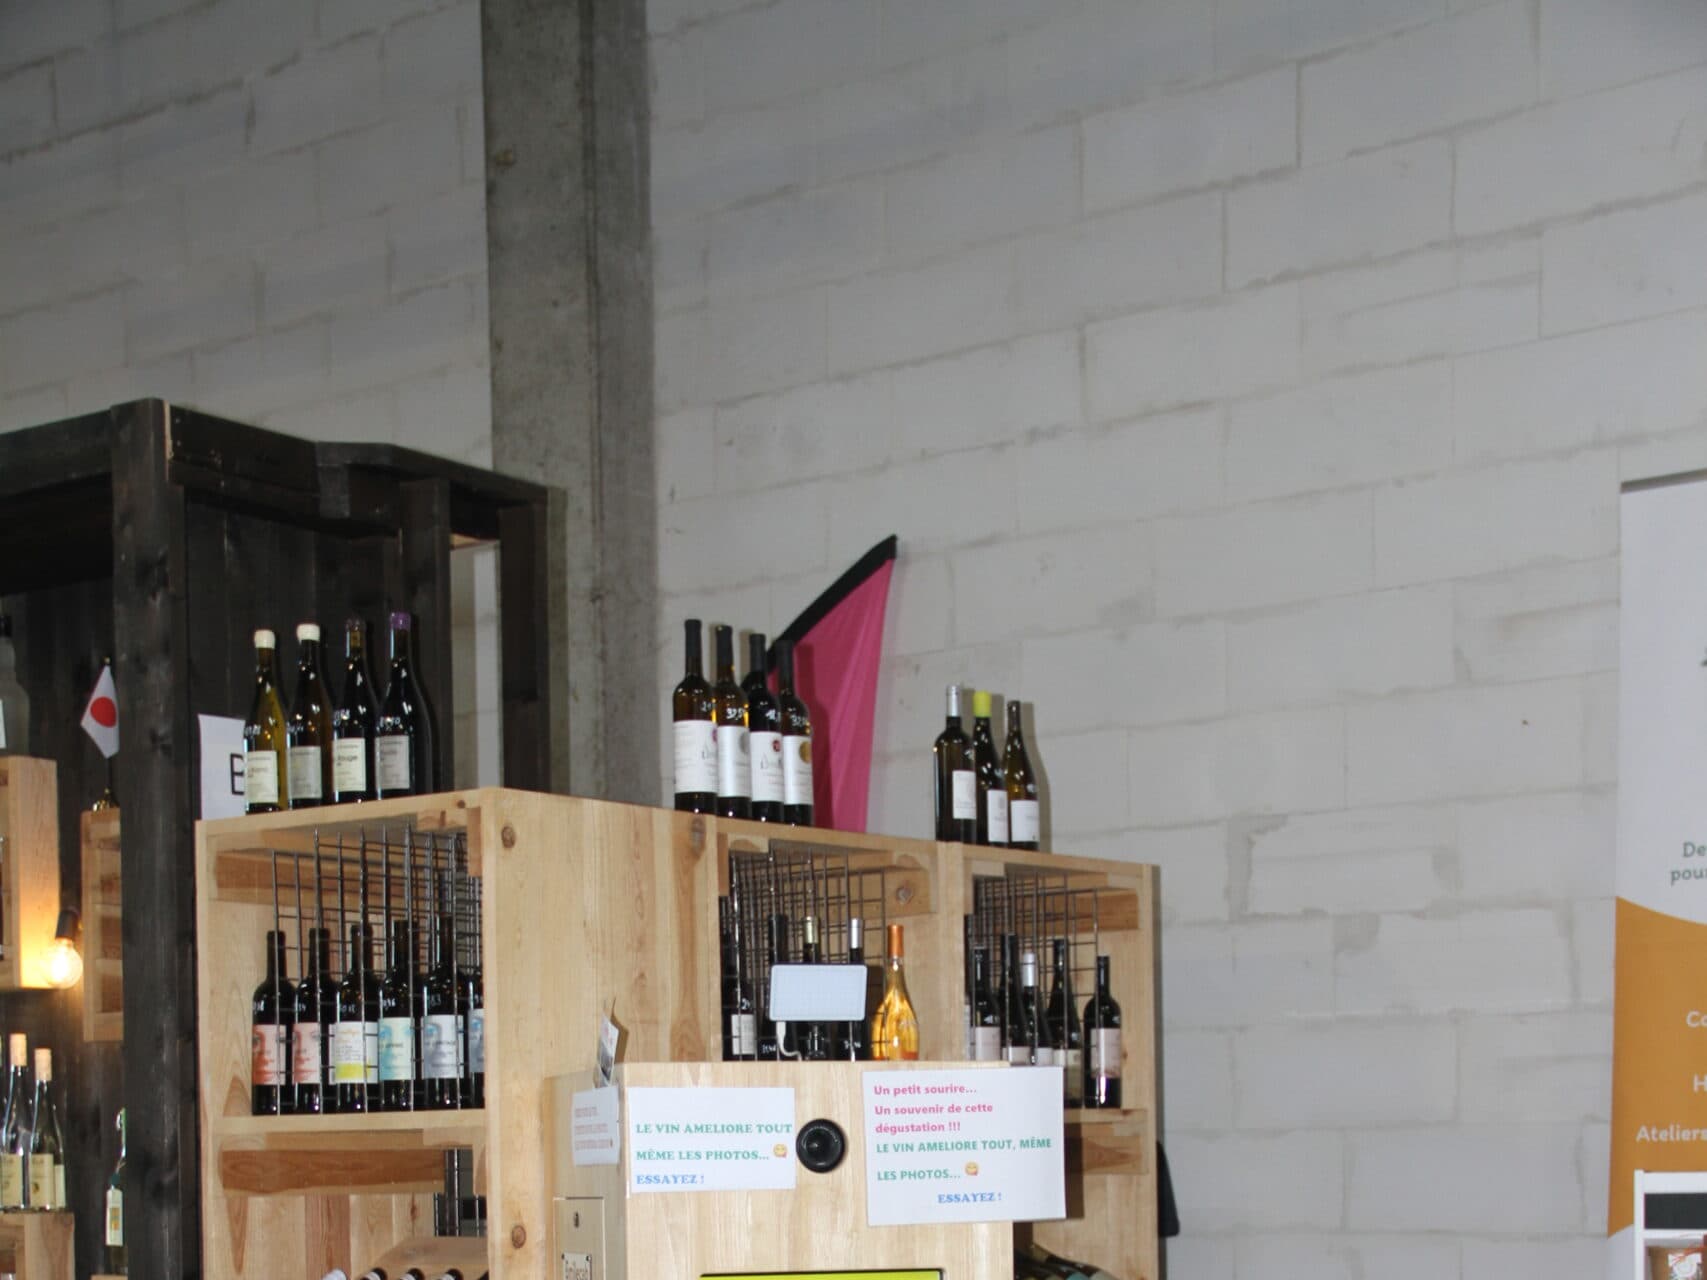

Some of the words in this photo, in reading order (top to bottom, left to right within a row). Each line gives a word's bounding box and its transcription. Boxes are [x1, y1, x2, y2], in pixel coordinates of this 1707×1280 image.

[873, 1085, 890, 1096] Un
[893, 1083, 921, 1097] petit
[924, 1083, 977, 1095] sourire...
[874, 1105, 891, 1116] Un
[894, 1103, 944, 1115] souvenir
[947, 1103, 962, 1114] de
[964, 1103, 993, 1113] cette
[636, 1124, 652, 1134] LE
[655, 1124, 680, 1134] VIN
[683, 1124, 753, 1134] AMELIORE
[756, 1124, 792, 1134] TOUT
[875, 1121, 945, 1136] dégustation
[948, 1121, 961, 1132] !!!
[876, 1142, 889, 1153] LE
[893, 1142, 914, 1153] VIN
[918, 1141, 977, 1153] AMELIORE
[981, 1139, 1016, 1151] TOUT,
[636, 1147, 675, 1160] MÊME
[678, 1150, 702, 1160] LES
[705, 1150, 769, 1160] PHOTOS...
[636, 1174, 697, 1185] ESSAYEZ
[877, 1170, 897, 1181] LES
[900, 1168, 961, 1181] PHOTOS...
[937, 1192, 995, 1204] ESSAYEZ
